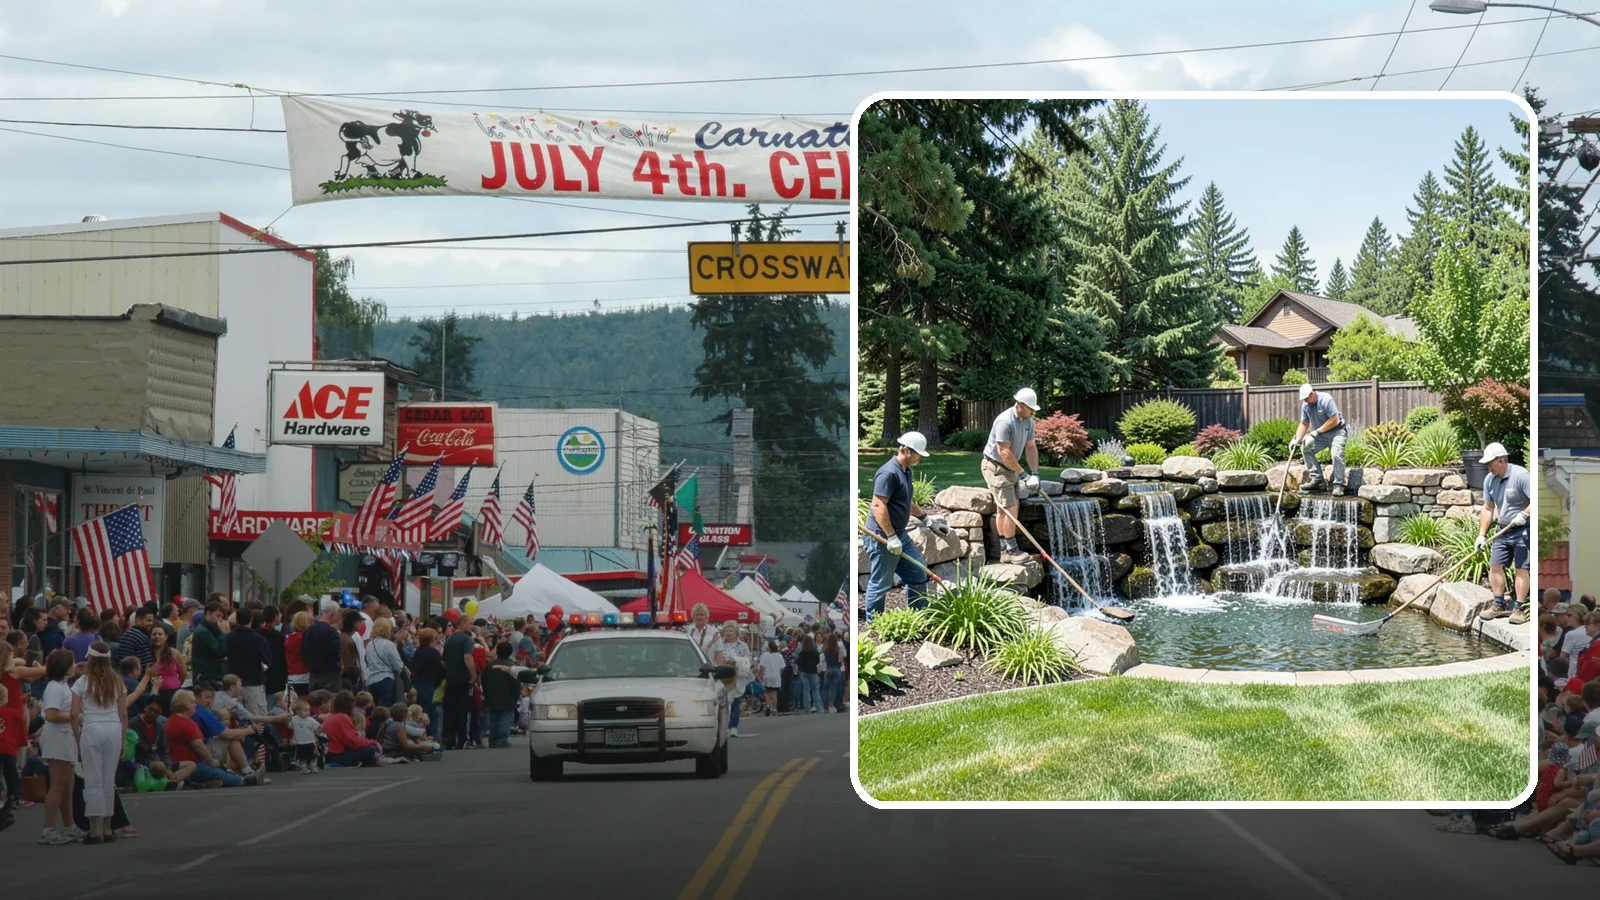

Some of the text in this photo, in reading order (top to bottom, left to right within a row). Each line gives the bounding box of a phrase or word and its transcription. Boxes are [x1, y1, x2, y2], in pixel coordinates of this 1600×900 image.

[695, 121, 850, 149] Carnat
[481, 141, 605, 192] JULY
[632, 150, 746, 198] 4th.
[697, 254, 850, 280] CROSSWA
[283, 380, 373, 420] ACE
[405, 409, 452, 422] CEDAR
[284, 421, 370, 436] Hardware
[416, 428, 477, 447] Coca-Cola
[353, 467, 387, 481] Simpl
[83, 485, 155, 495] St. Vincent de Paul
[212, 516, 331, 535] HARDARE
[688, 526, 741, 535] CRNATION
[700, 535, 730, 543] GLASS
